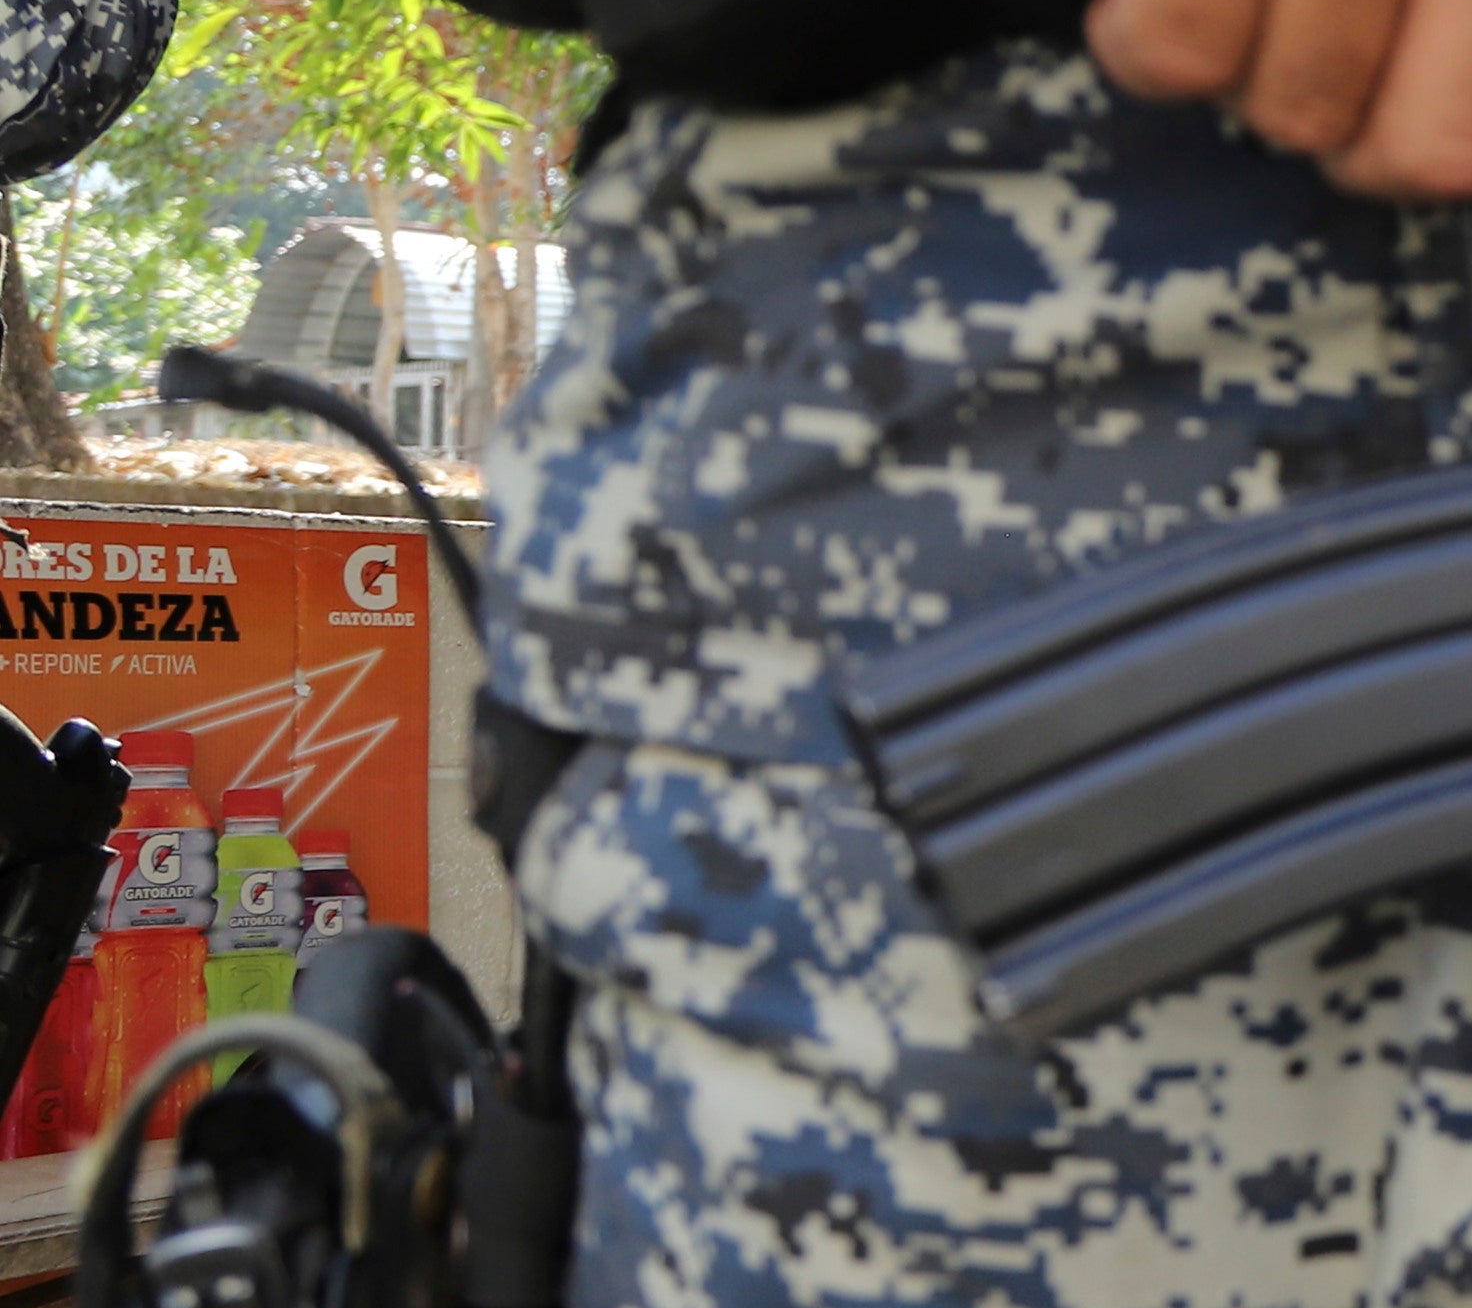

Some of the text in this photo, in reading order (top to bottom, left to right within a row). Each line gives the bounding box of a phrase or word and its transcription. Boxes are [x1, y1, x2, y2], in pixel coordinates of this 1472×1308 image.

[103, 544, 238, 584] DE LA
[328, 611, 416, 627] GATORADE
[15, 653, 197, 675] REPONE ACTIVA
[124, 885, 194, 900] GATORADE
[228, 915, 286, 928] GATORADE
